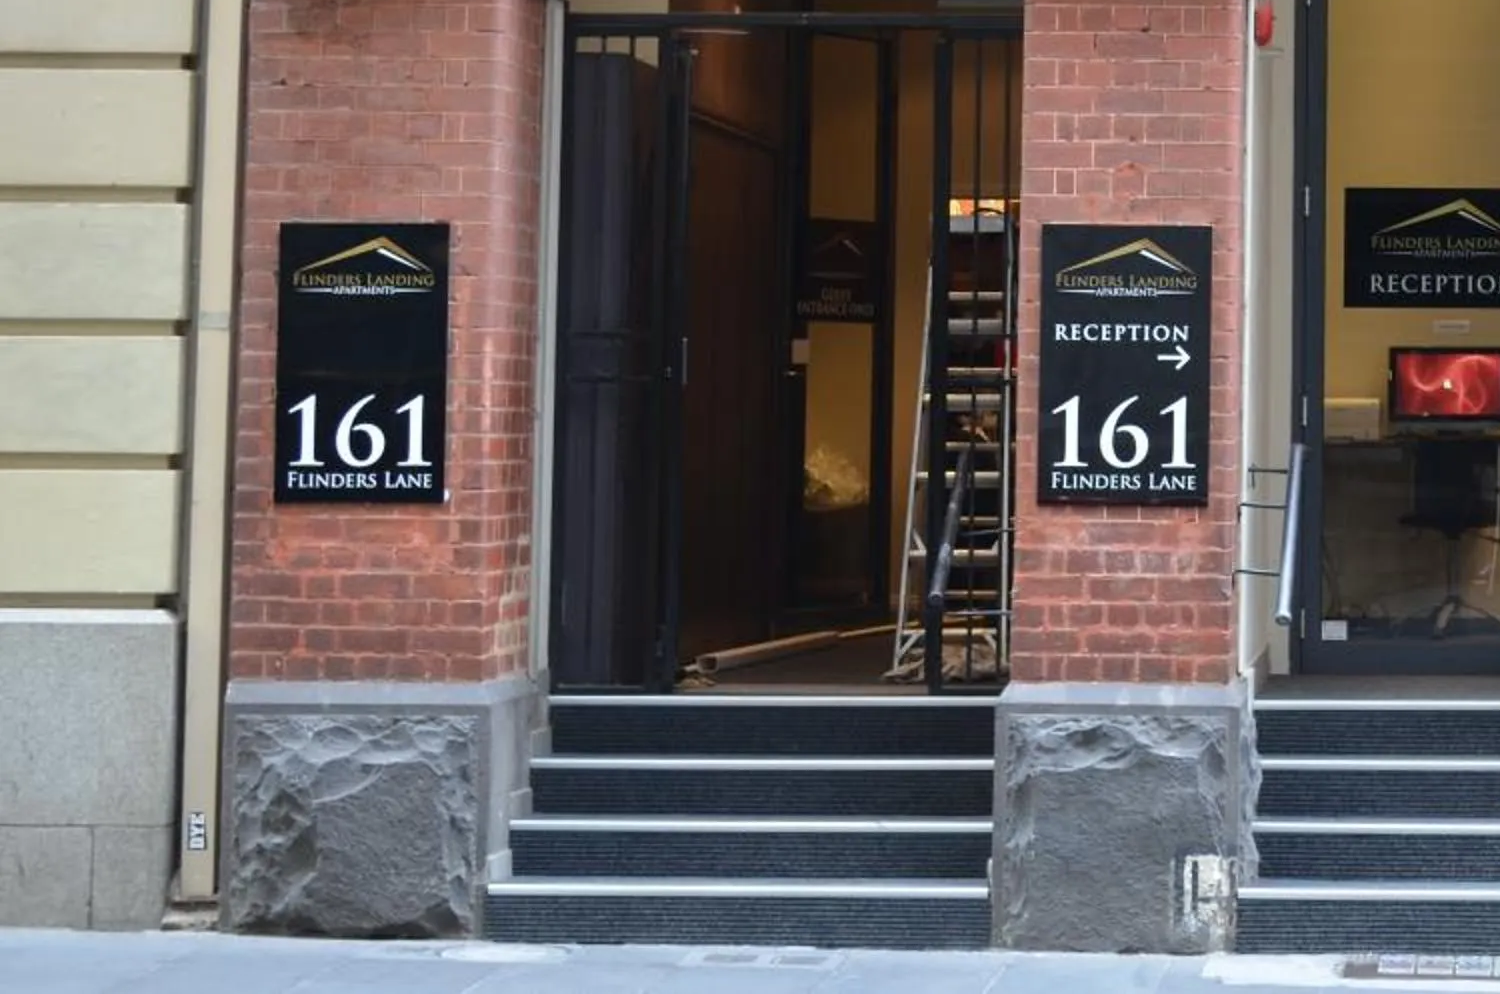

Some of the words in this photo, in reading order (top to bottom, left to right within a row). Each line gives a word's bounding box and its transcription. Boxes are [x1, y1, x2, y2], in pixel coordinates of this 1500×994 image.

[1370, 235, 1442, 250] FLINDERS
[293, 272, 362, 287] FLINDERS
[367, 272, 435, 287] LANDING
[1055, 272, 1124, 288] FLINDERS
[1129, 273, 1198, 289] LANDING
[331, 285, 397, 296] APARTMENTS
[1095, 286, 1158, 298] APARTMENTS
[1054, 323, 1190, 342] RECEPTION
[287, 393, 433, 468] 161
[1051, 394, 1197, 469] 161
[287, 471, 377, 489] FLINDERS
[385, 471, 433, 489] LANE
[1051, 471, 1141, 490] FLINDERS
[1148, 472, 1197, 491] LANE
